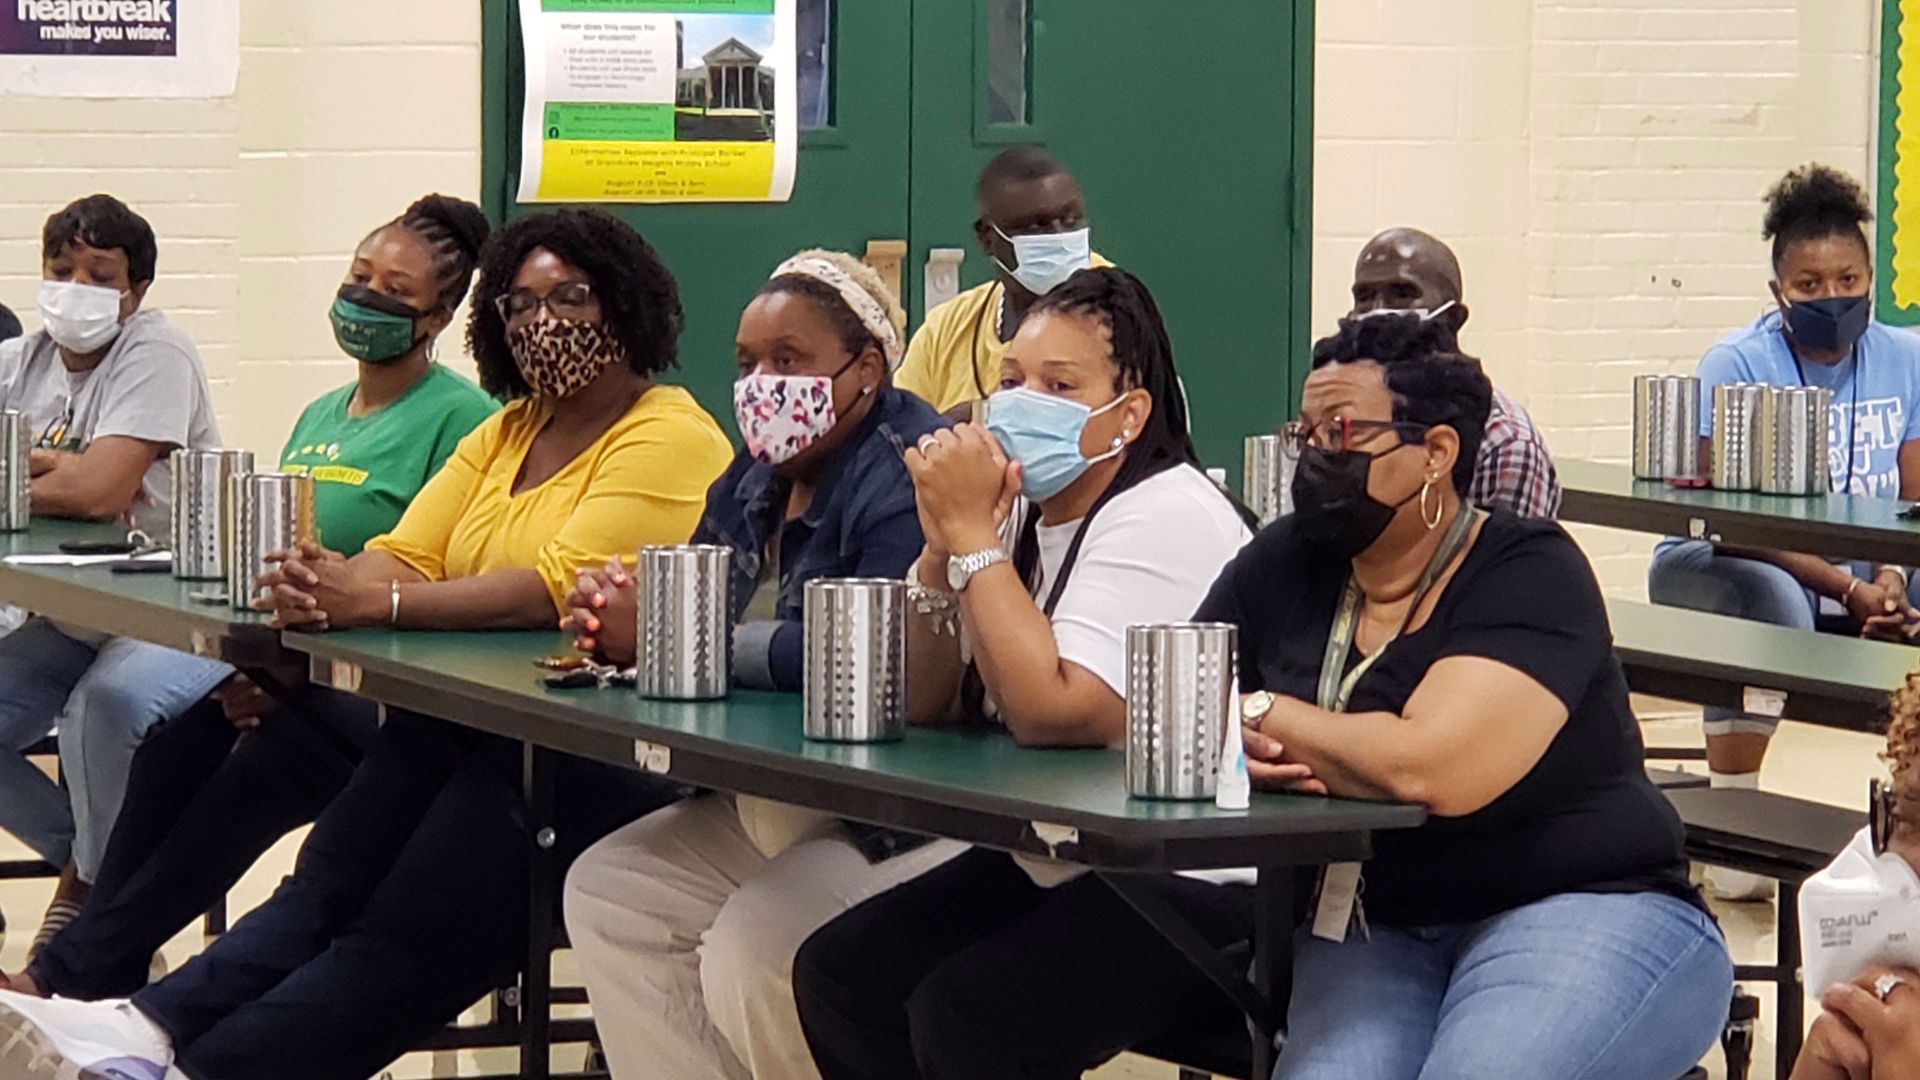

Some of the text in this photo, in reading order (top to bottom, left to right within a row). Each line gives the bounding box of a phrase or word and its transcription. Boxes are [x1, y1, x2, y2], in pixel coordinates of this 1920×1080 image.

[17, 0, 172, 22] heartbreak
[40, 23, 171, 43] makes you wiser.
